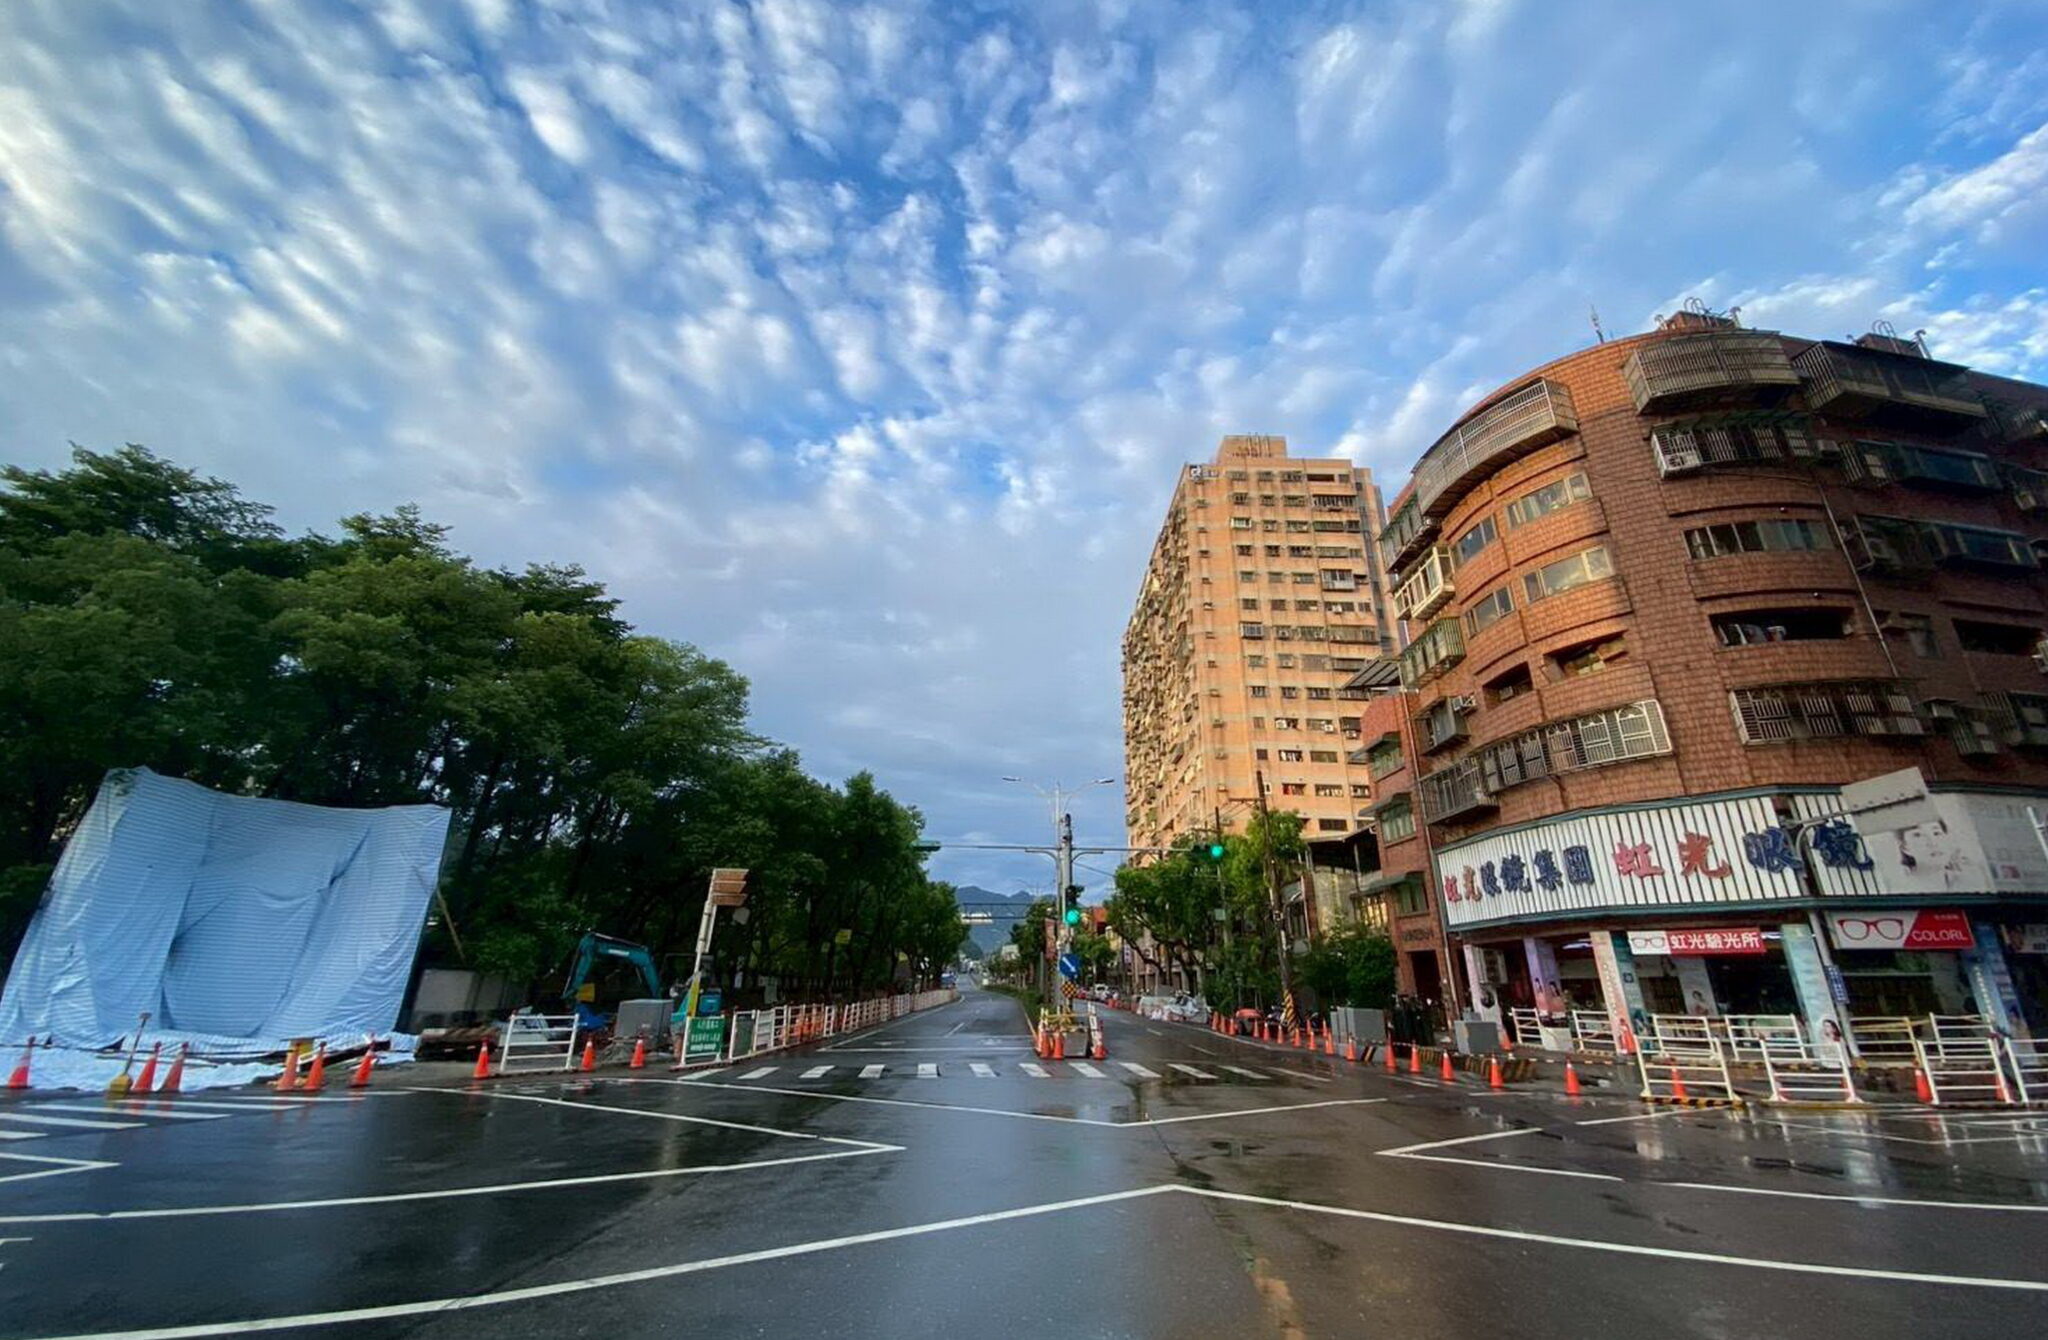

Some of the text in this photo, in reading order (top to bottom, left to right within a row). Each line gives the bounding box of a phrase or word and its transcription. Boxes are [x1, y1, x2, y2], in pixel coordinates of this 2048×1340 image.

[1612, 819, 1875, 879] 虹光眼鏡
[1670, 931, 1761, 949] 虹光驗光所
